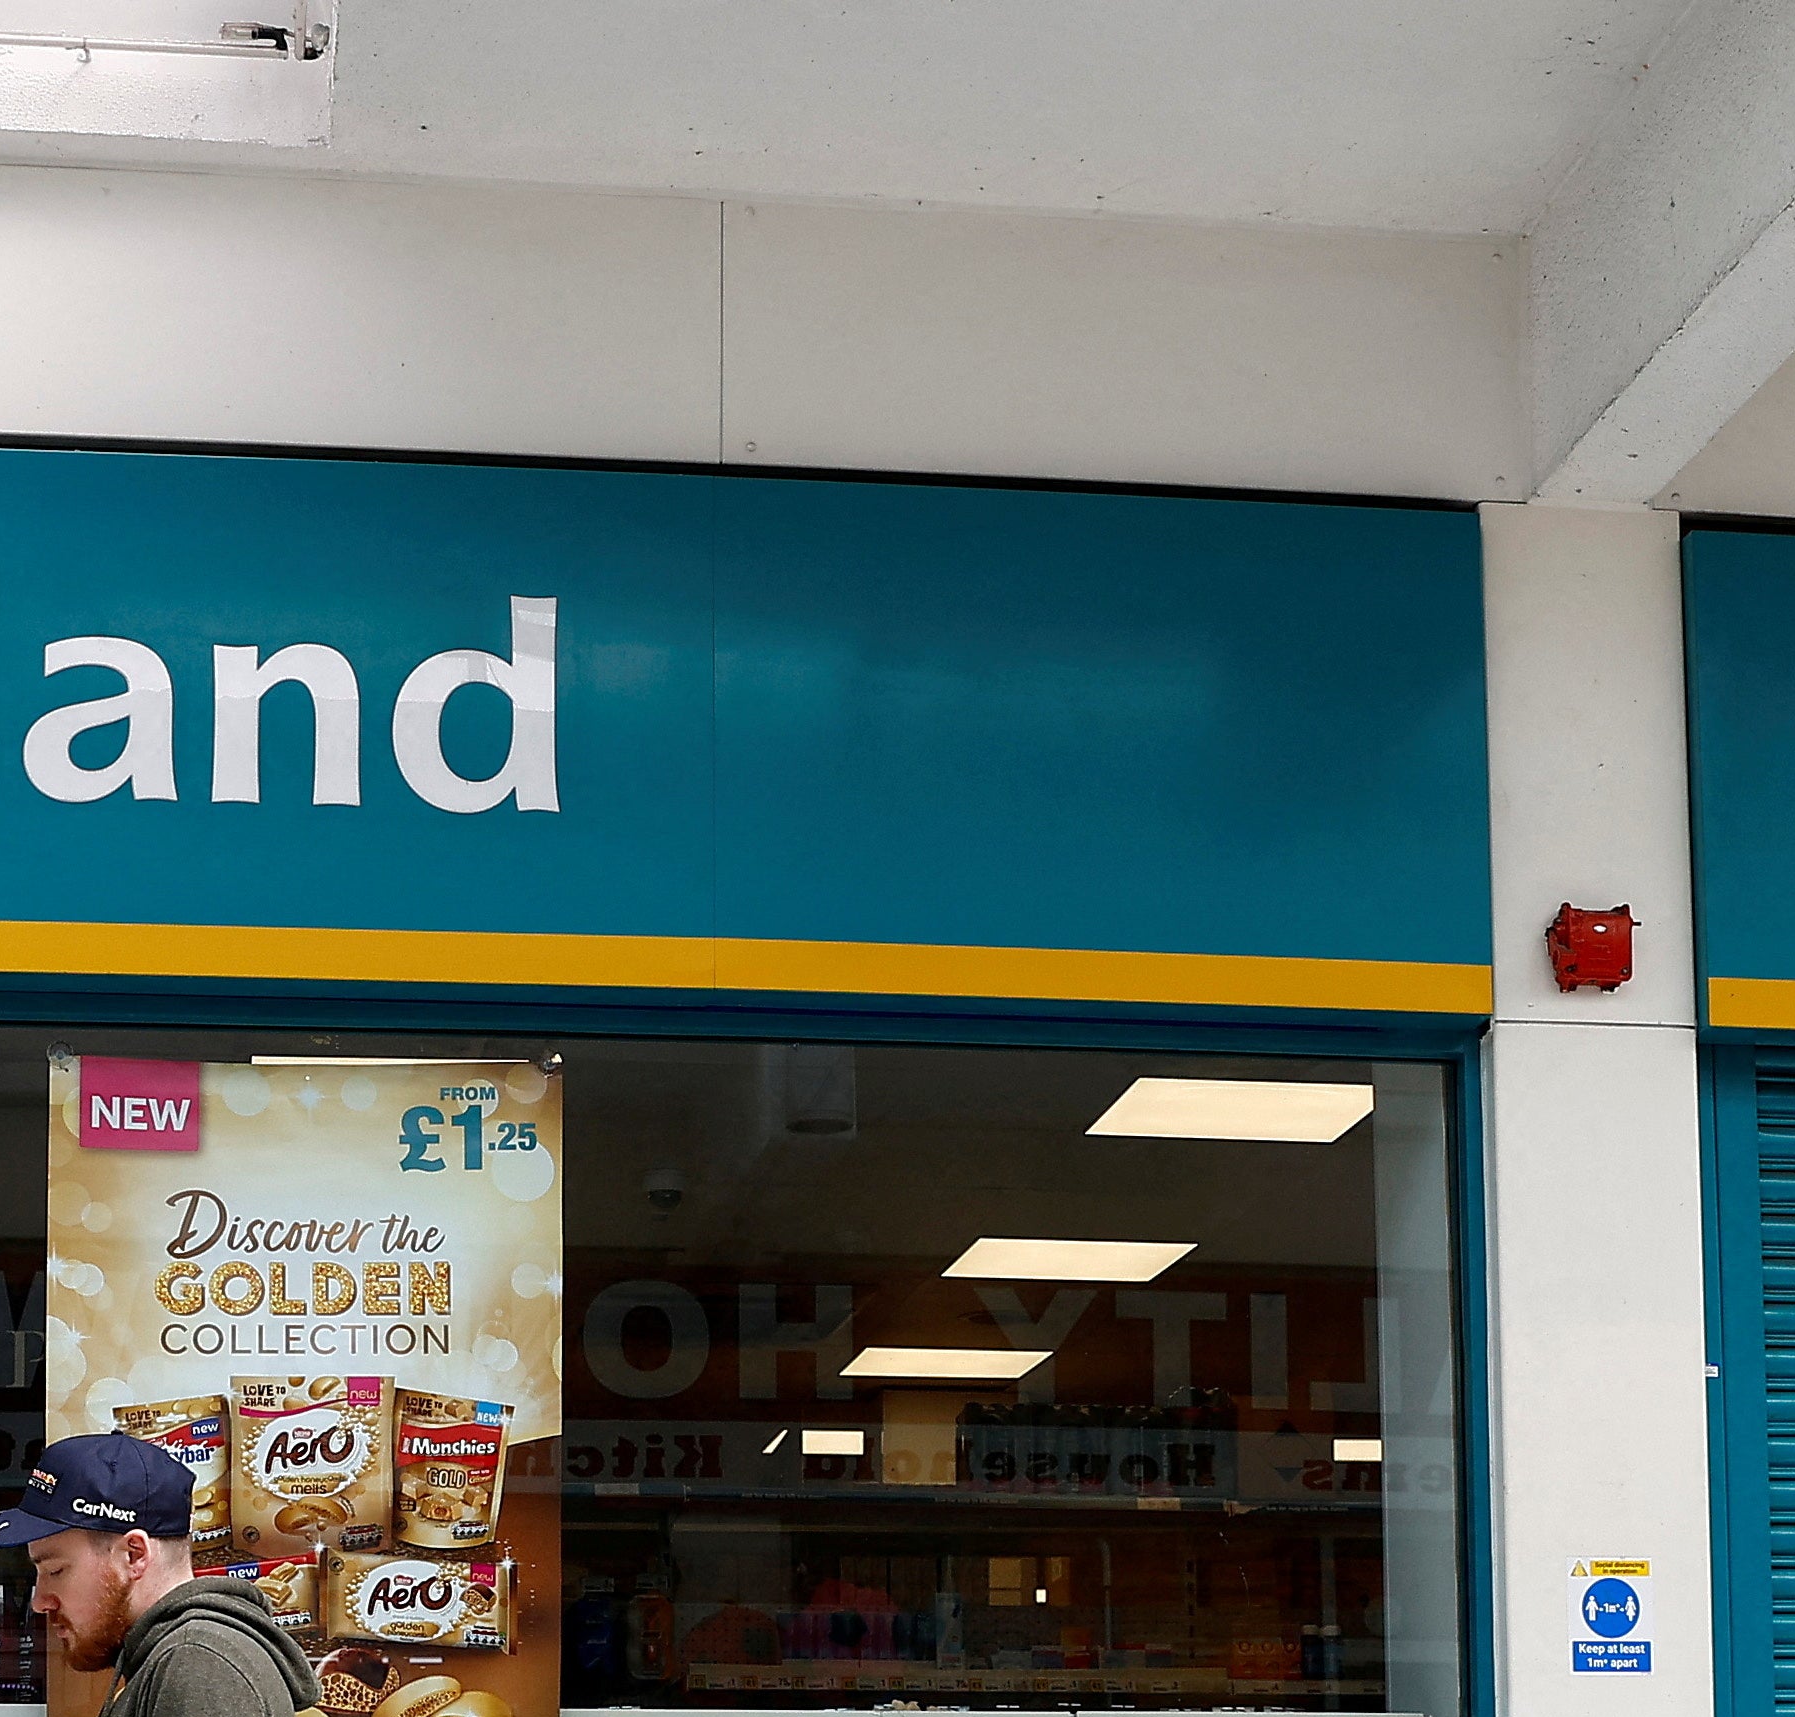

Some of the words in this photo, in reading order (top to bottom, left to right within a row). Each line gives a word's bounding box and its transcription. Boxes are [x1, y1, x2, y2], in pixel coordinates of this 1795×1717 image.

[440, 1086, 497, 1101] FROM
[90, 1096, 191, 1133] NEW
[399, 1104, 537, 1172] £1.25
[165, 1189, 373, 1260] Discover
[380, 1212, 446, 1254] the
[154, 1260, 452, 1316] GOLDEN
[159, 1322, 451, 1356] COLLECTION
[242, 1384, 274, 1397] LOVE
[276, 1385, 286, 1395] TO
[349, 1388, 378, 1400] new
[242, 1396, 276, 1407] SHARE
[476, 1412, 499, 1424] NEW
[191, 1422, 220, 1436] new
[265, 1425, 355, 1475] Aero
[411, 1437, 496, 1455] Munchies
[173, 1446, 215, 1464] ybar
[427, 1467, 466, 1489] GOLD
[72, 1498, 136, 1522] CarNext
[228, 1566, 258, 1579] new
[1595, 1561, 1613, 1569] Social
[1614, 1561, 1645, 1570] distancing
[471, 1572, 494, 1582] new
[367, 1575, 453, 1616] Aero
[1578, 1643, 1606, 1655] Keep
[1607, 1644, 1619, 1654] at
[1619, 1643, 1646, 1655] least
[1610, 1658, 1638, 1670] apart
